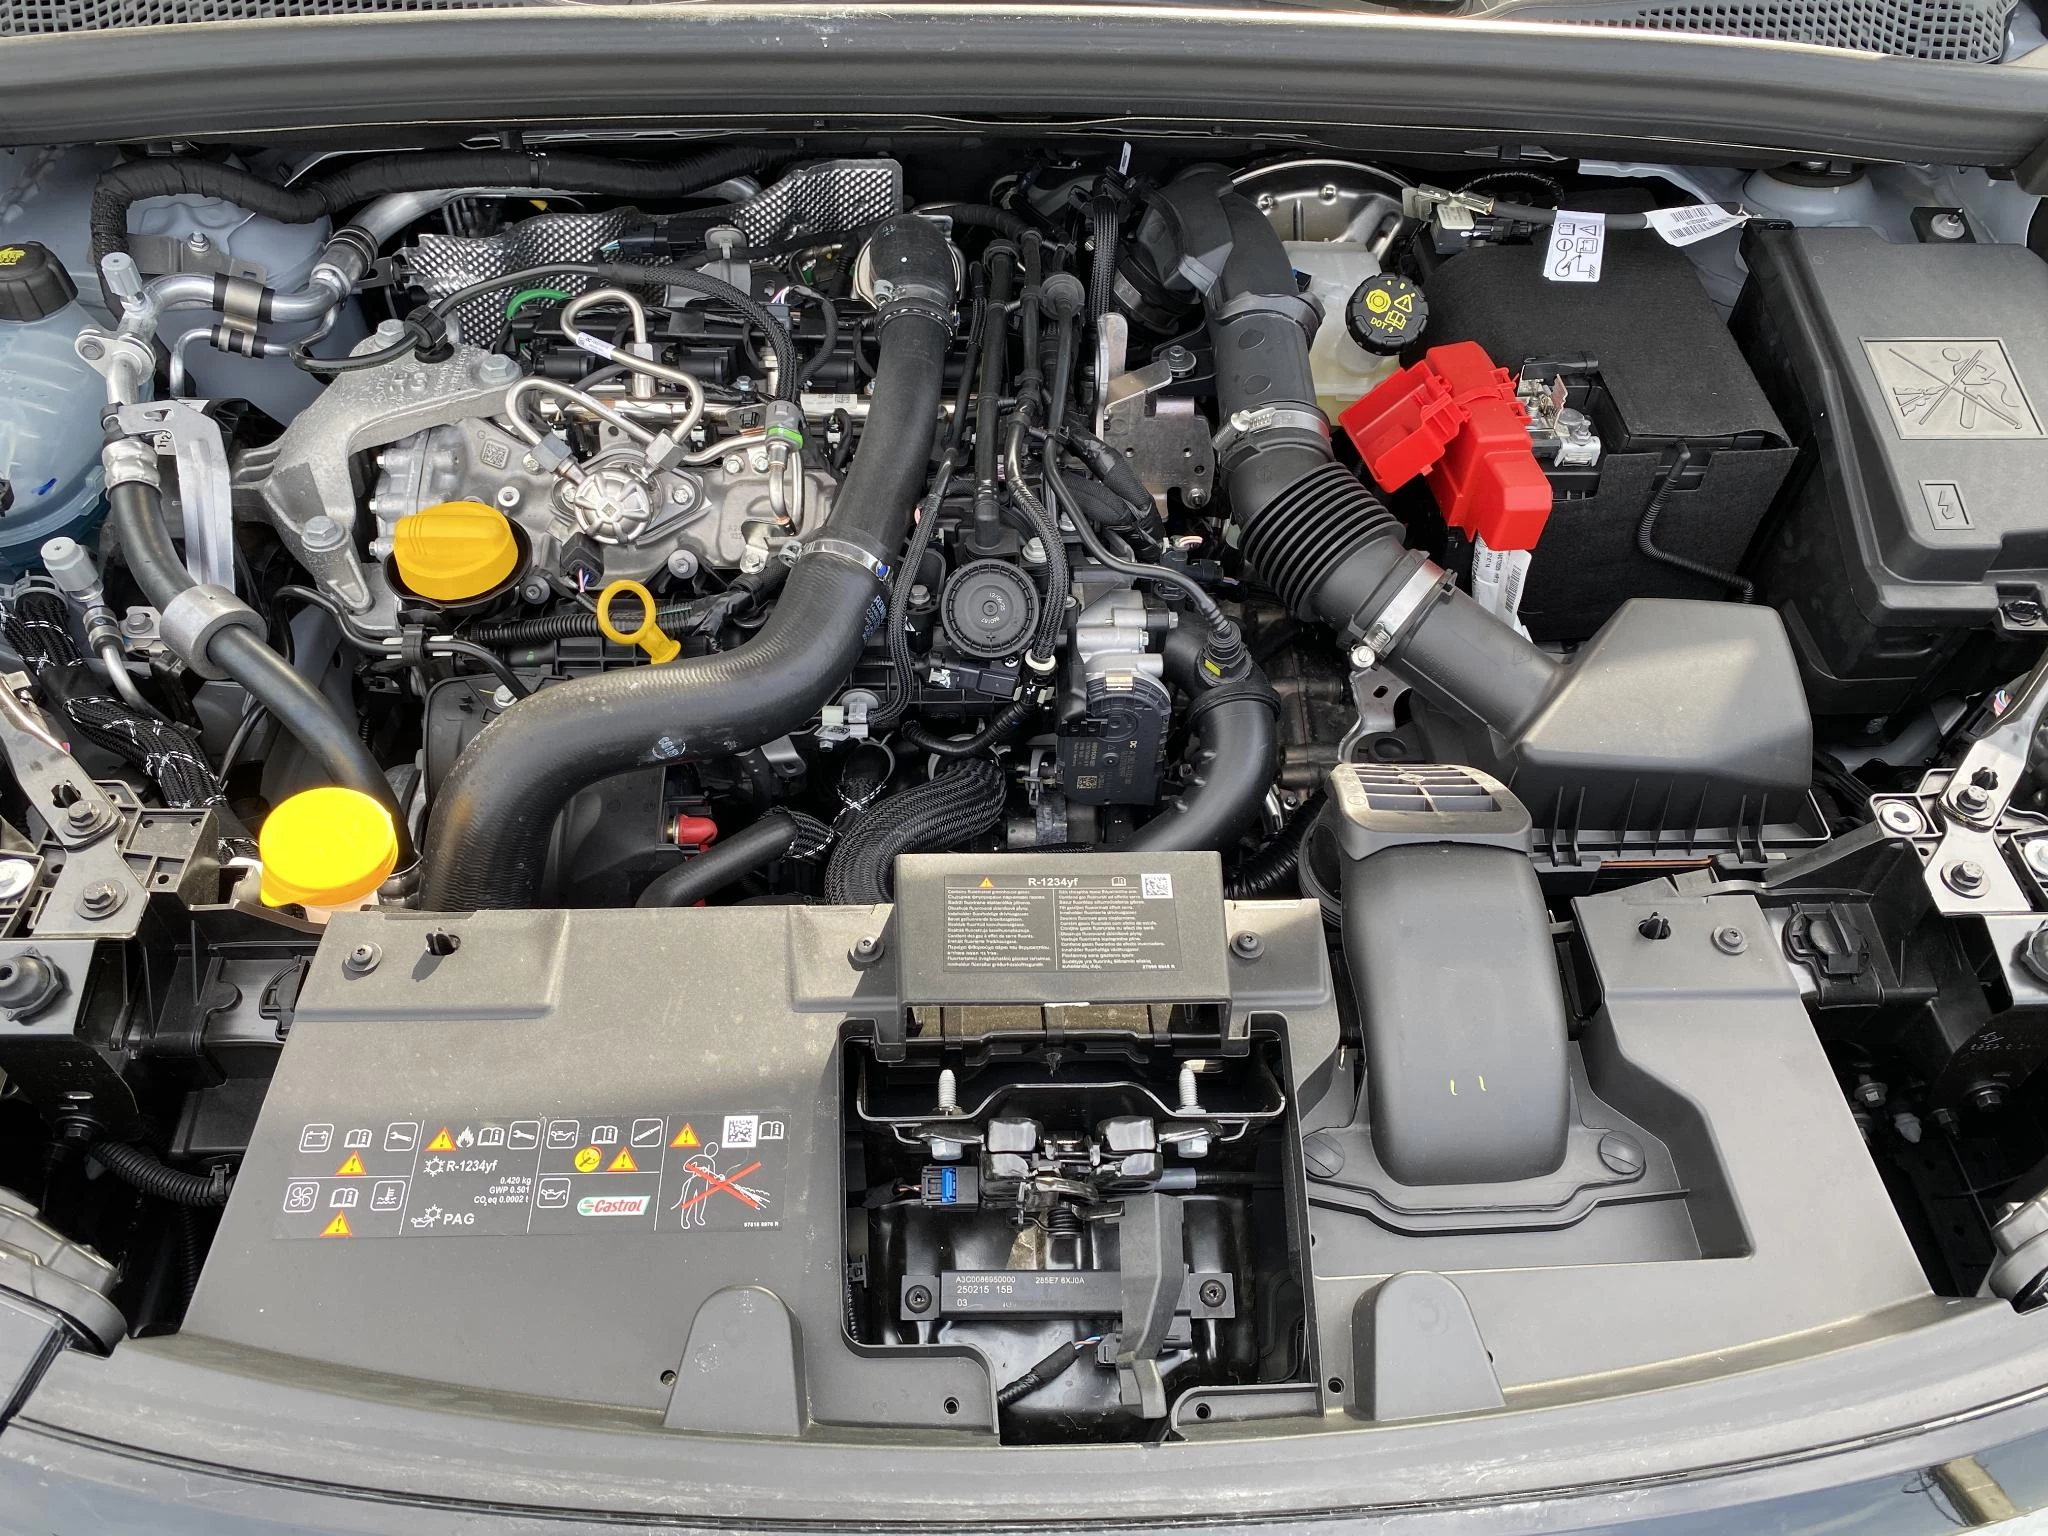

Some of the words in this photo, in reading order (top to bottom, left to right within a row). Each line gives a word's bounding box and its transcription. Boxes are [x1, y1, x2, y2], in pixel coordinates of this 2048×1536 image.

[1370, 316, 1388, 330] DOT
[1387, 326, 1394, 334] 4
[1129, 740, 1138, 749] DC
[1028, 877, 1079, 888] R-1234yf
[446, 1160, 499, 1174] R-1234yf
[500, 1176, 521, 1185] 0.420
[521, 1176, 531, 1186] kg
[489, 1186, 509, 1194] GWP
[509, 1186, 530, 1194] 0.501
[499, 1195, 524, 1203] 0.0002
[594, 1199, 643, 1213] Castrol
[442, 1213, 475, 1225] PAG
[955, 1275, 1016, 1284] A3C0086950000
[956, 1285, 990, 1294] 250215
[996, 1285, 1013, 1294] 15B
[956, 1298, 968, 1307] 03
